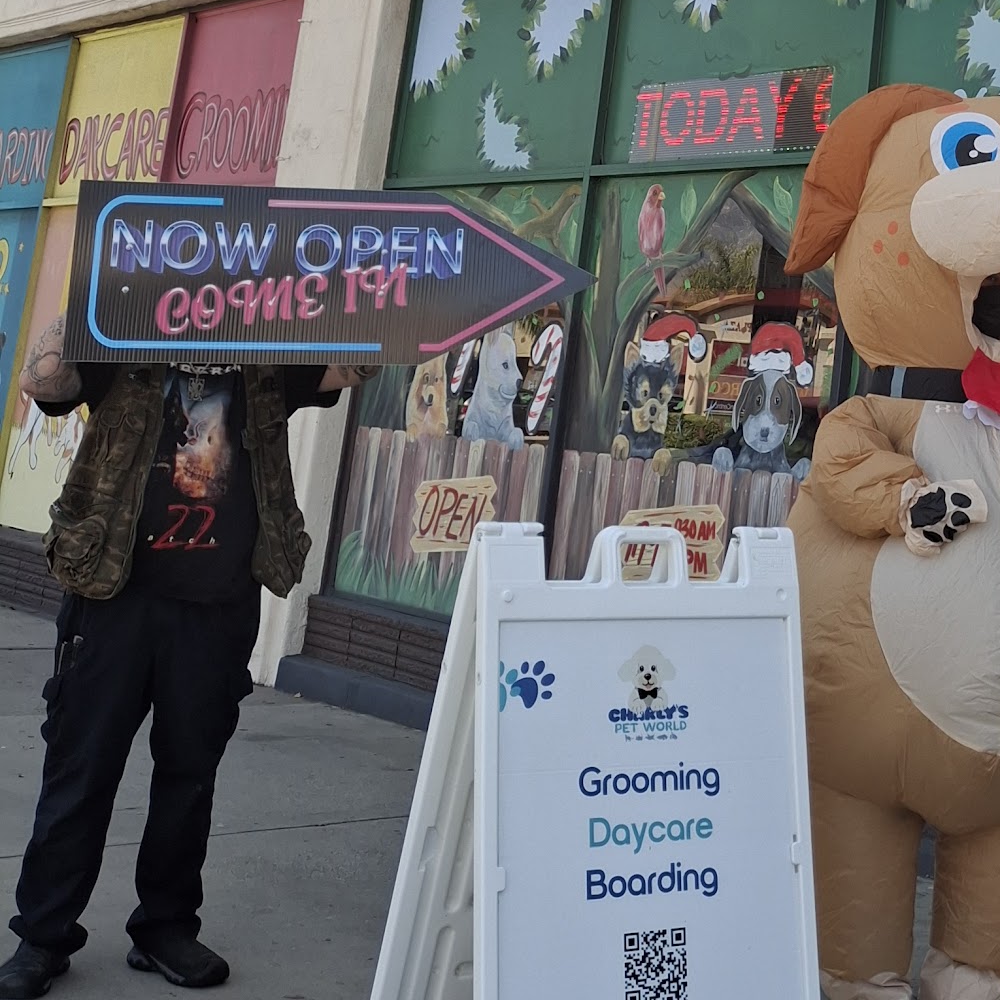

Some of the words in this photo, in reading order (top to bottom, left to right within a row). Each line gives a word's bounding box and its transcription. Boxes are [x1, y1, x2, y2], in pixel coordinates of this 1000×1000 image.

[637, 78, 802, 147] TODAY
[58, 107, 171, 185] DAYCARE
[110, 219, 276, 276] NOW
[294, 223, 464, 279] OPEN
[155, 272, 328, 335] COME
[341, 262, 408, 314] IN
[152, 504, 220, 551] 22
[418, 484, 487, 542] OPEN
[697, 520, 716, 541] AM
[608, 704, 690, 722] CHARLY'S
[614, 722, 639, 734] PET
[643, 720, 687, 732] WORLD
[578, 761, 720, 797] Grooming
[589, 817, 713, 855] Daycare
[586, 861, 719, 900] Boarding
